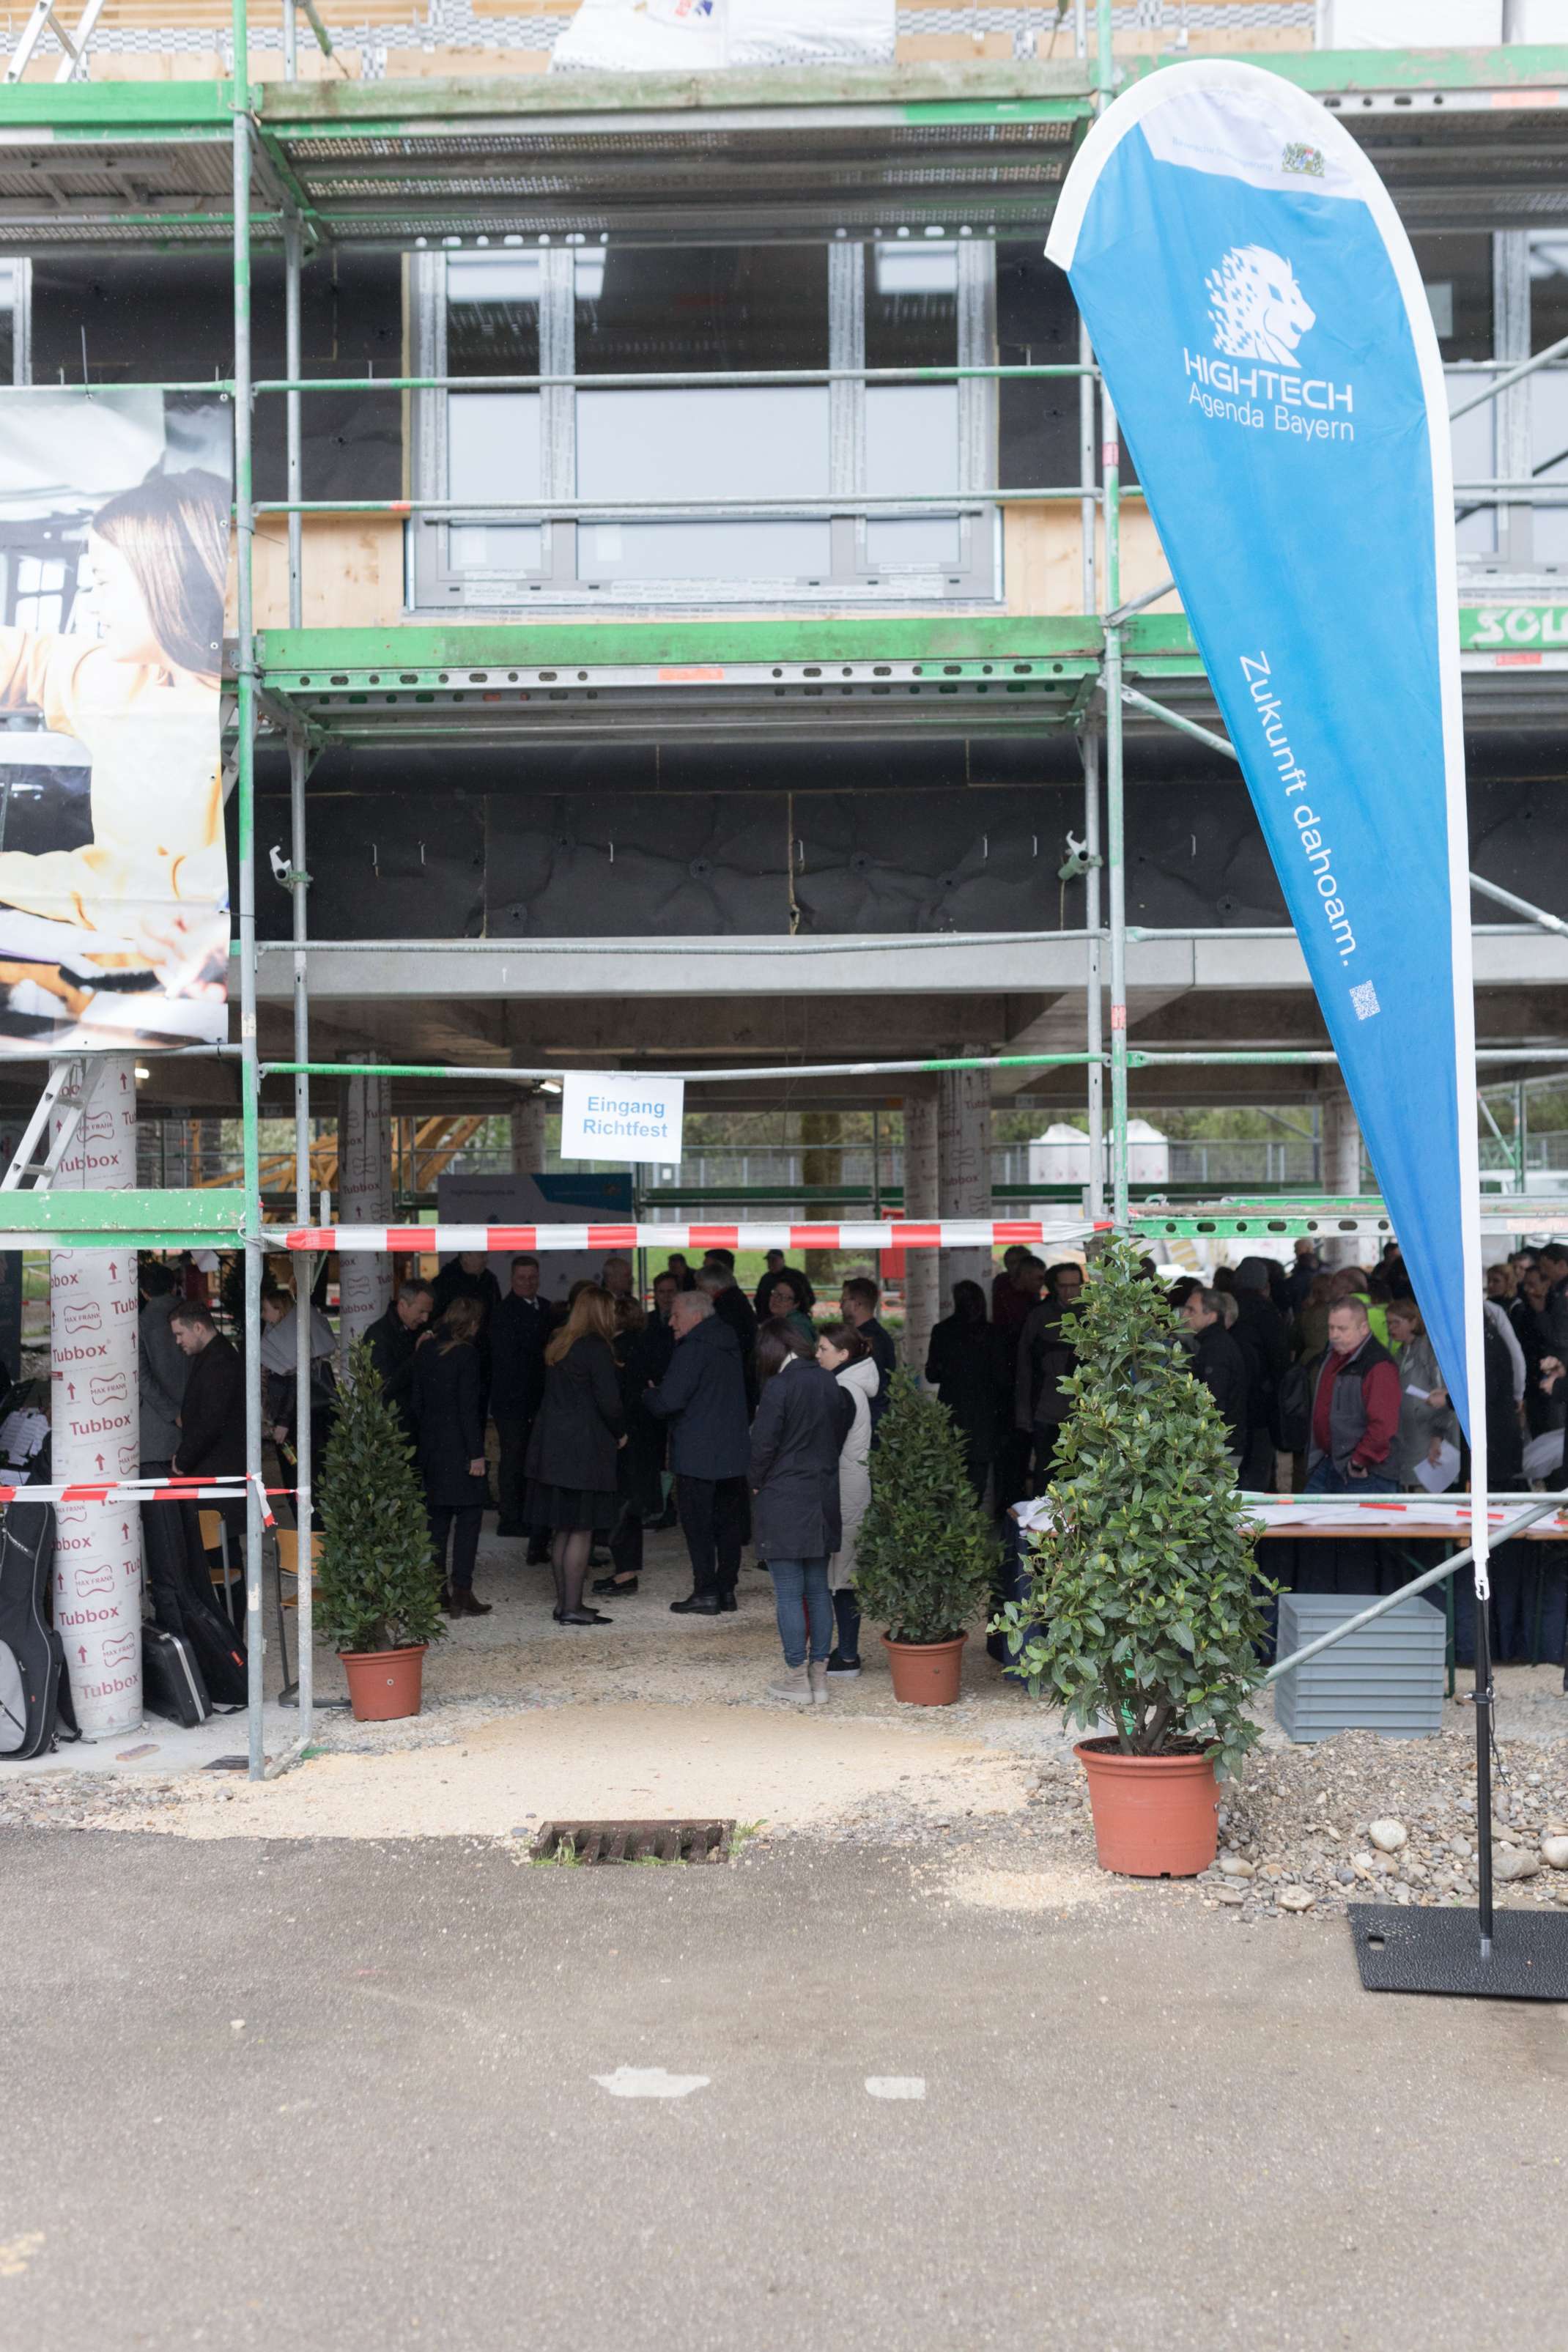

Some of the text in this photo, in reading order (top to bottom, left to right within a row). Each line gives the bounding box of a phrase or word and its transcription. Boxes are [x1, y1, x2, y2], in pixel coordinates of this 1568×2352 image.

[1184, 347, 1353, 413] HIGHTECH
[1189, 381, 1354, 442] Agenda Bayern
[1240, 650, 1356, 966] Zukunft dahoam.
[588, 1096, 665, 1117] Eingang
[583, 1119, 668, 1137] Richtfest
[59, 1154, 119, 1172] Tubbox
[53, 1345, 107, 1363] Tubbox
[69, 1414, 131, 1435] Tubbox
[59, 1606, 119, 1626] Tubbox
[80, 1674, 139, 1699] Tubbox
